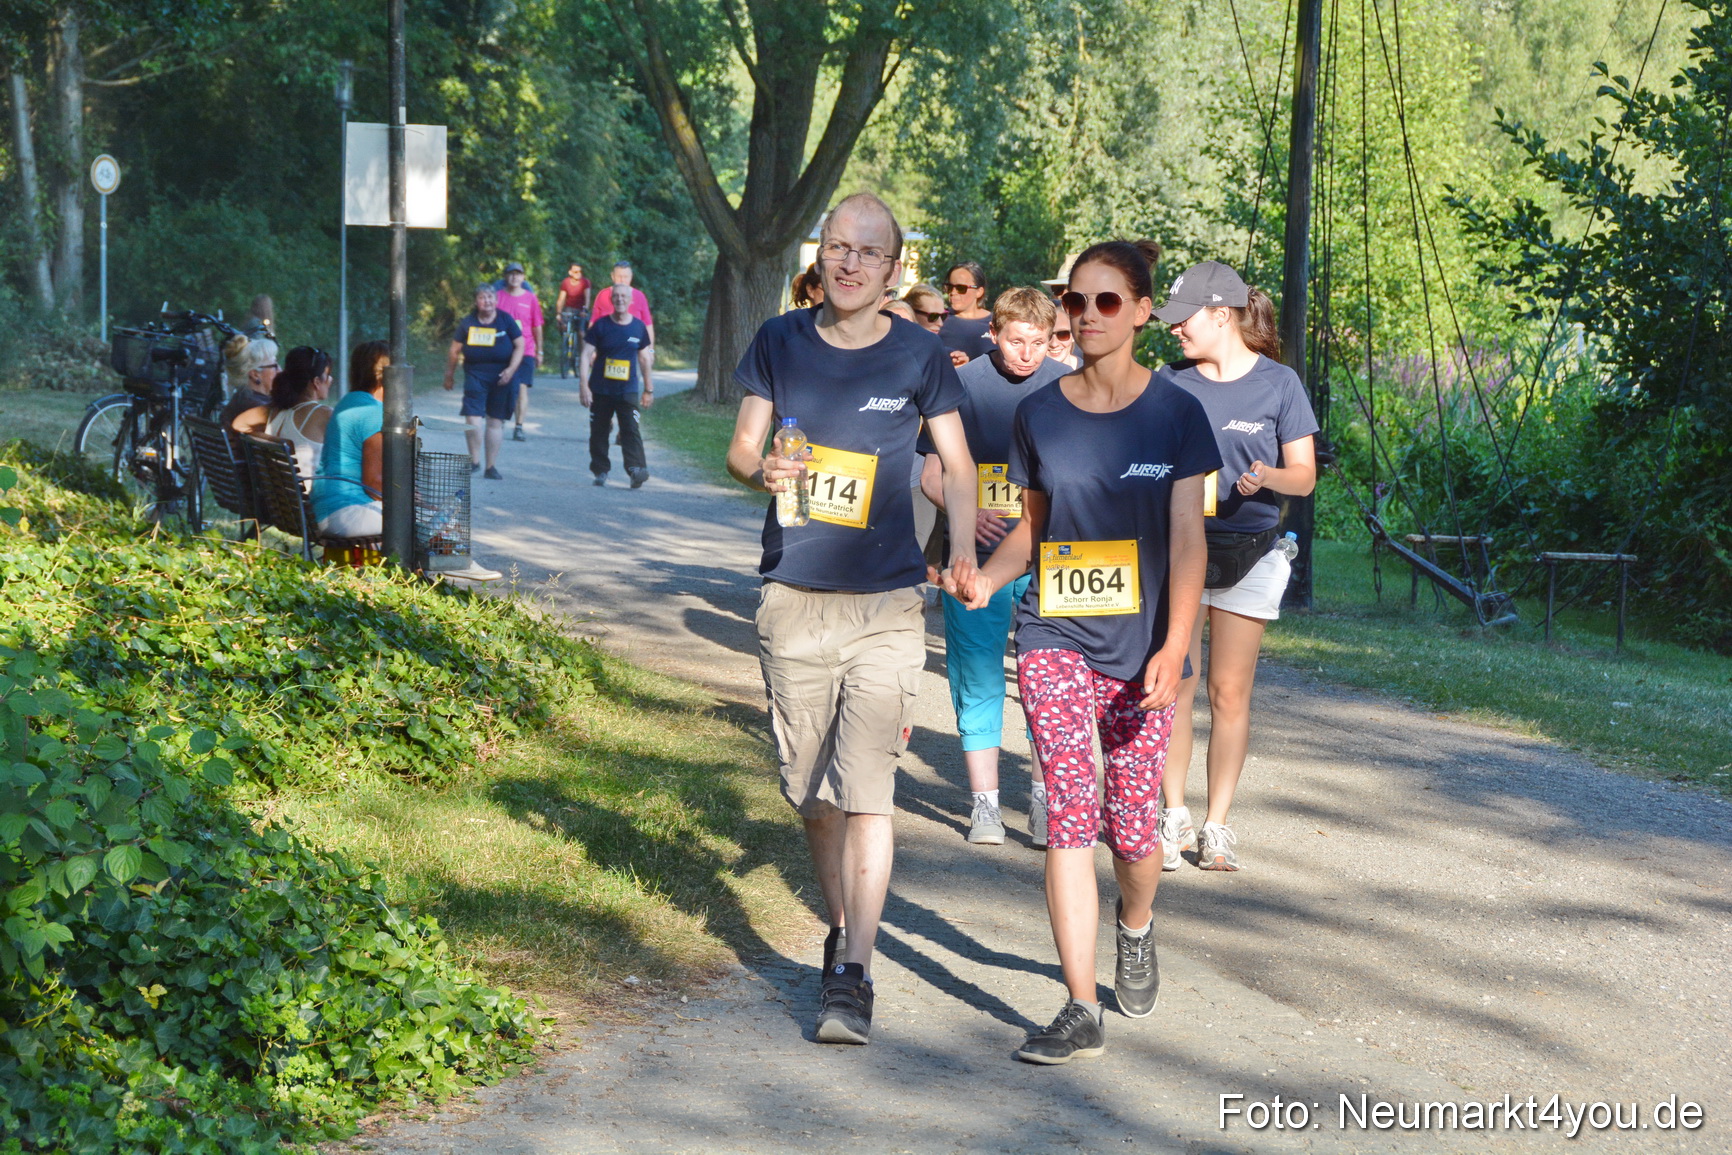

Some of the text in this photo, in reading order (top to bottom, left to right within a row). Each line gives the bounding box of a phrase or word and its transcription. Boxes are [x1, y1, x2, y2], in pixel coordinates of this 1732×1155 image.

[607, 365, 626, 374] 1104
[828, 502, 854, 513] Patrick
[1052, 567, 1125, 595] 1064
[1063, 595, 1113, 604] Schorr Ronja
